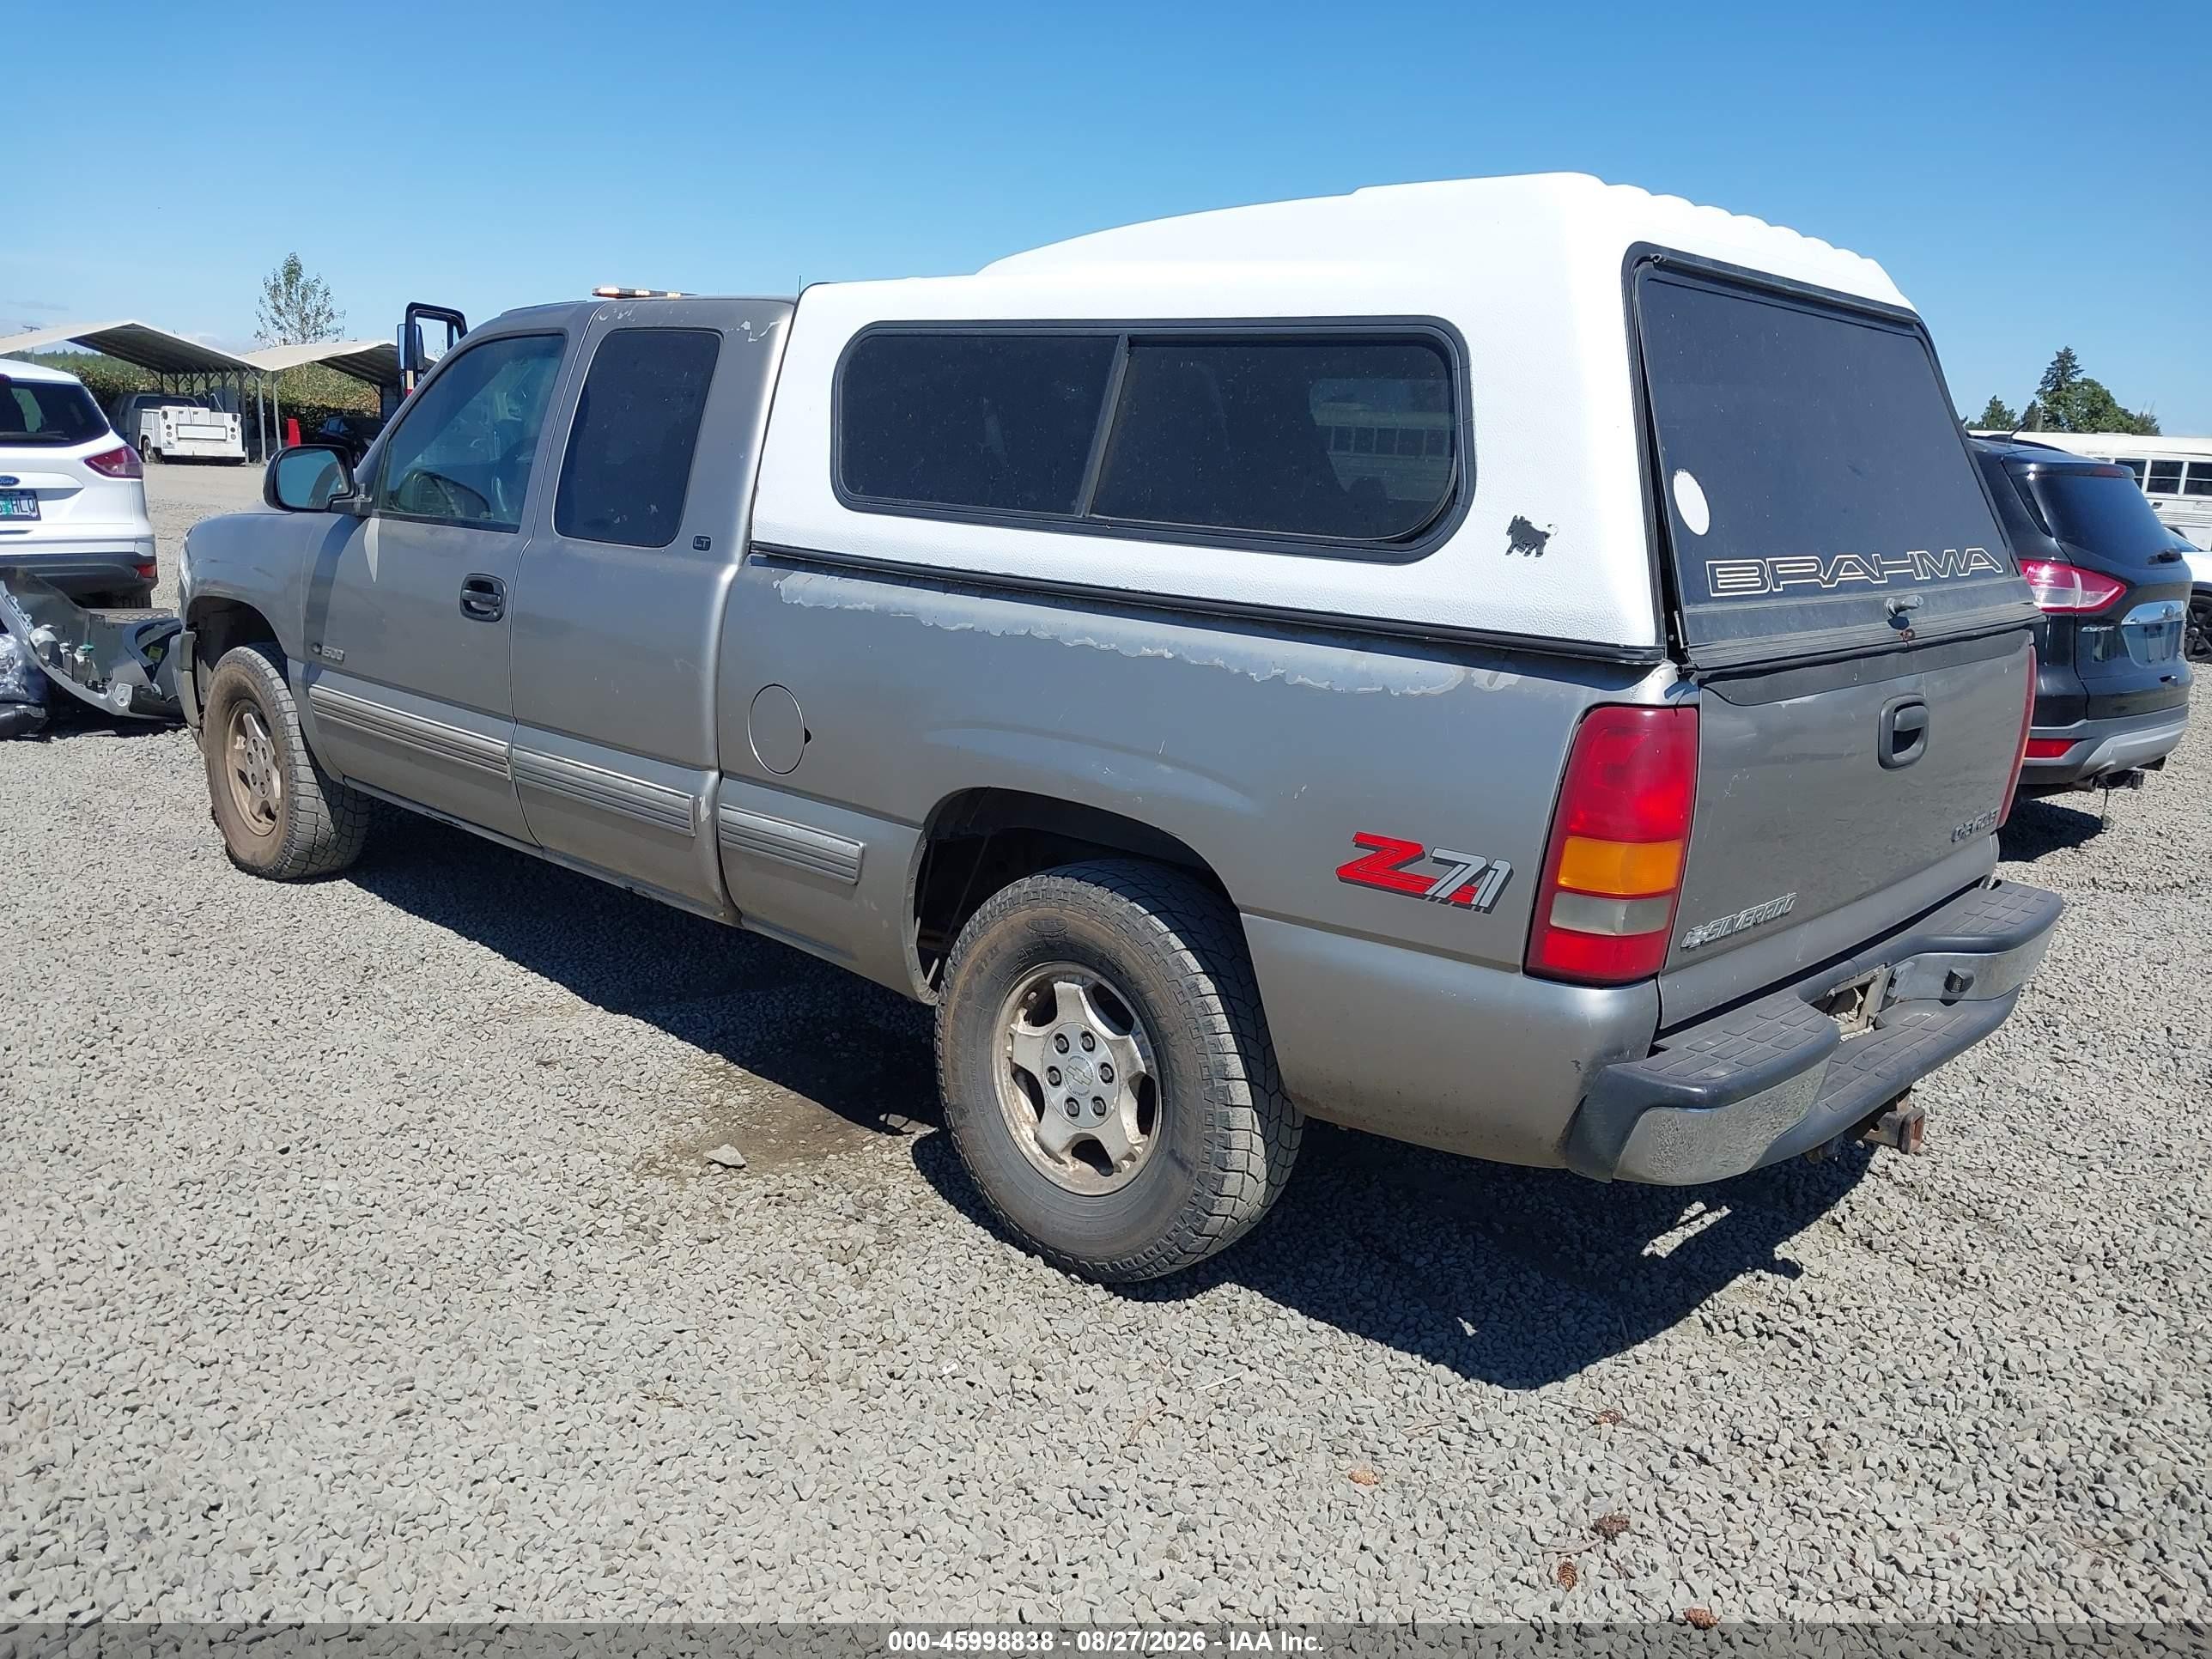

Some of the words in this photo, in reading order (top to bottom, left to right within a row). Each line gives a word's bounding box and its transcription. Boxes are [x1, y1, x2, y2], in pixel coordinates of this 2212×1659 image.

[693, 537, 711, 550] LT
[1705, 546, 2004, 599] BRAHMA
[1336, 831, 1515, 915] Z71
[1705, 891, 1799, 944] SILVERADO
